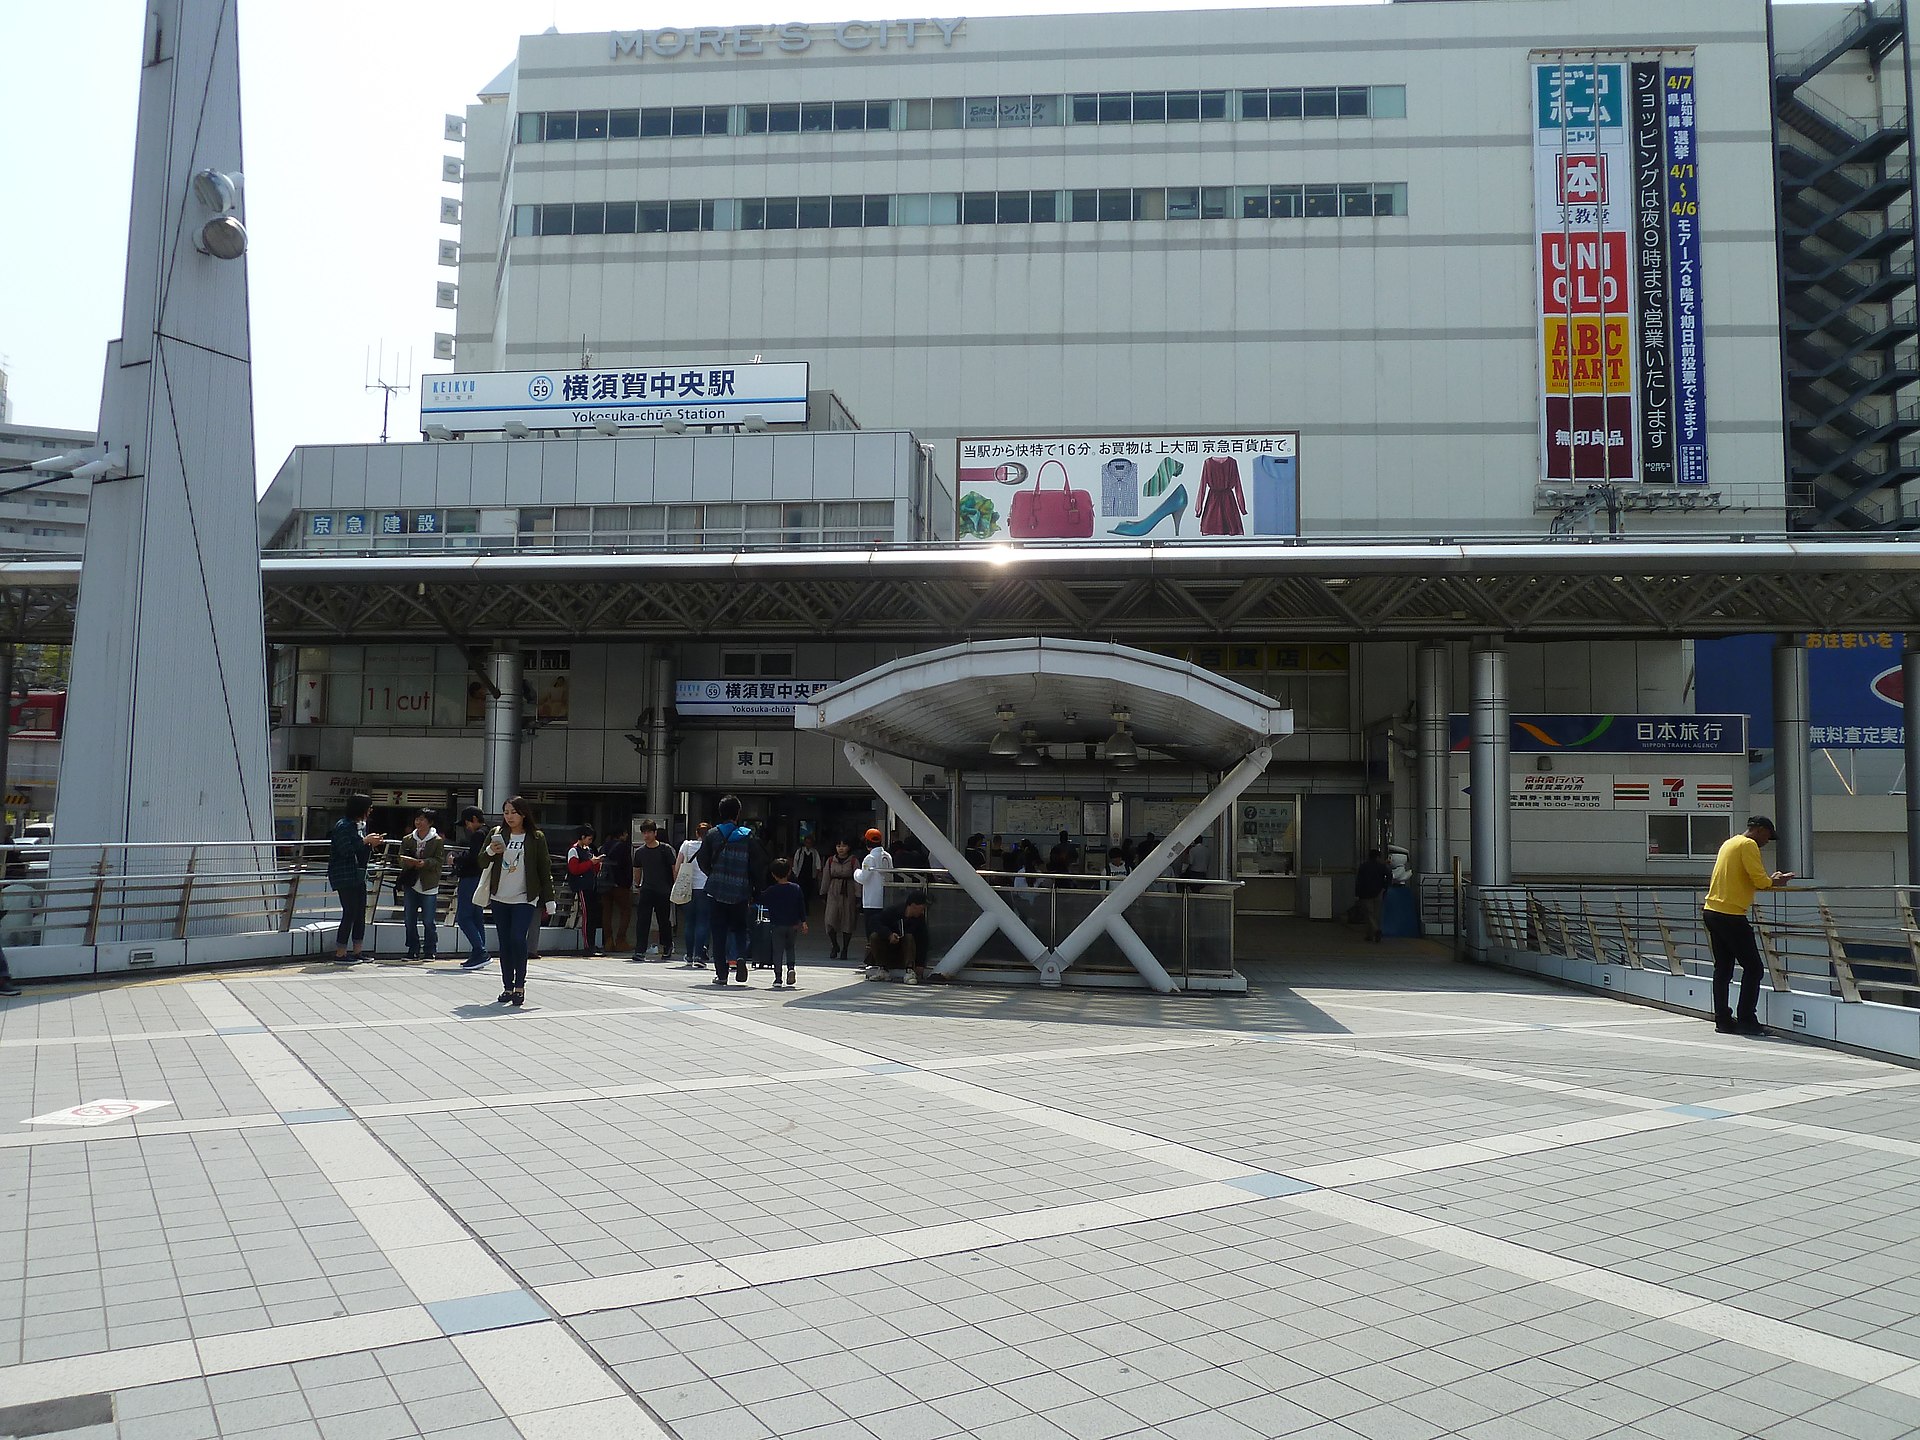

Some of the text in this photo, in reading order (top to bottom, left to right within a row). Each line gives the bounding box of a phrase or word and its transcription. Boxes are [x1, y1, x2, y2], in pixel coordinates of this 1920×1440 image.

[609, 16, 967, 59] MORE'S CITY
[1549, 69, 1609, 96] デコ
[1667, 75, 1692, 90] 4/7
[1550, 96, 1612, 123] ホーム
[1680, 92, 1694, 128] 県知事
[1566, 131, 1597, 143] ニトリ
[1673, 130, 1690, 160] 選挙
[1562, 161, 1604, 198] 本
[1670, 165, 1694, 179] 4/1
[1558, 208, 1611, 225] 文教堂
[1671, 202, 1696, 216] 4/6
[1551, 242, 1611, 271] UNI
[1552, 276, 1618, 310] QLO
[1551, 323, 1623, 356] ABC
[1552, 359, 1624, 380] MART
[432, 380, 476, 394] KEIKYU
[533, 385, 549, 397] 59
[562, 369, 736, 402] 横須賀中央駅
[677, 408, 726, 420] Station
[1555, 430, 1624, 446] 無印良品
[314, 514, 435, 535] 京急建設
[708, 688, 719, 697] 59
[1637, 722, 1723, 741] 日本旅行
[737, 751, 774, 766] 東口
[1524, 775, 1586, 784] 京浜急行バス
[1662, 778, 1685, 806] 7
